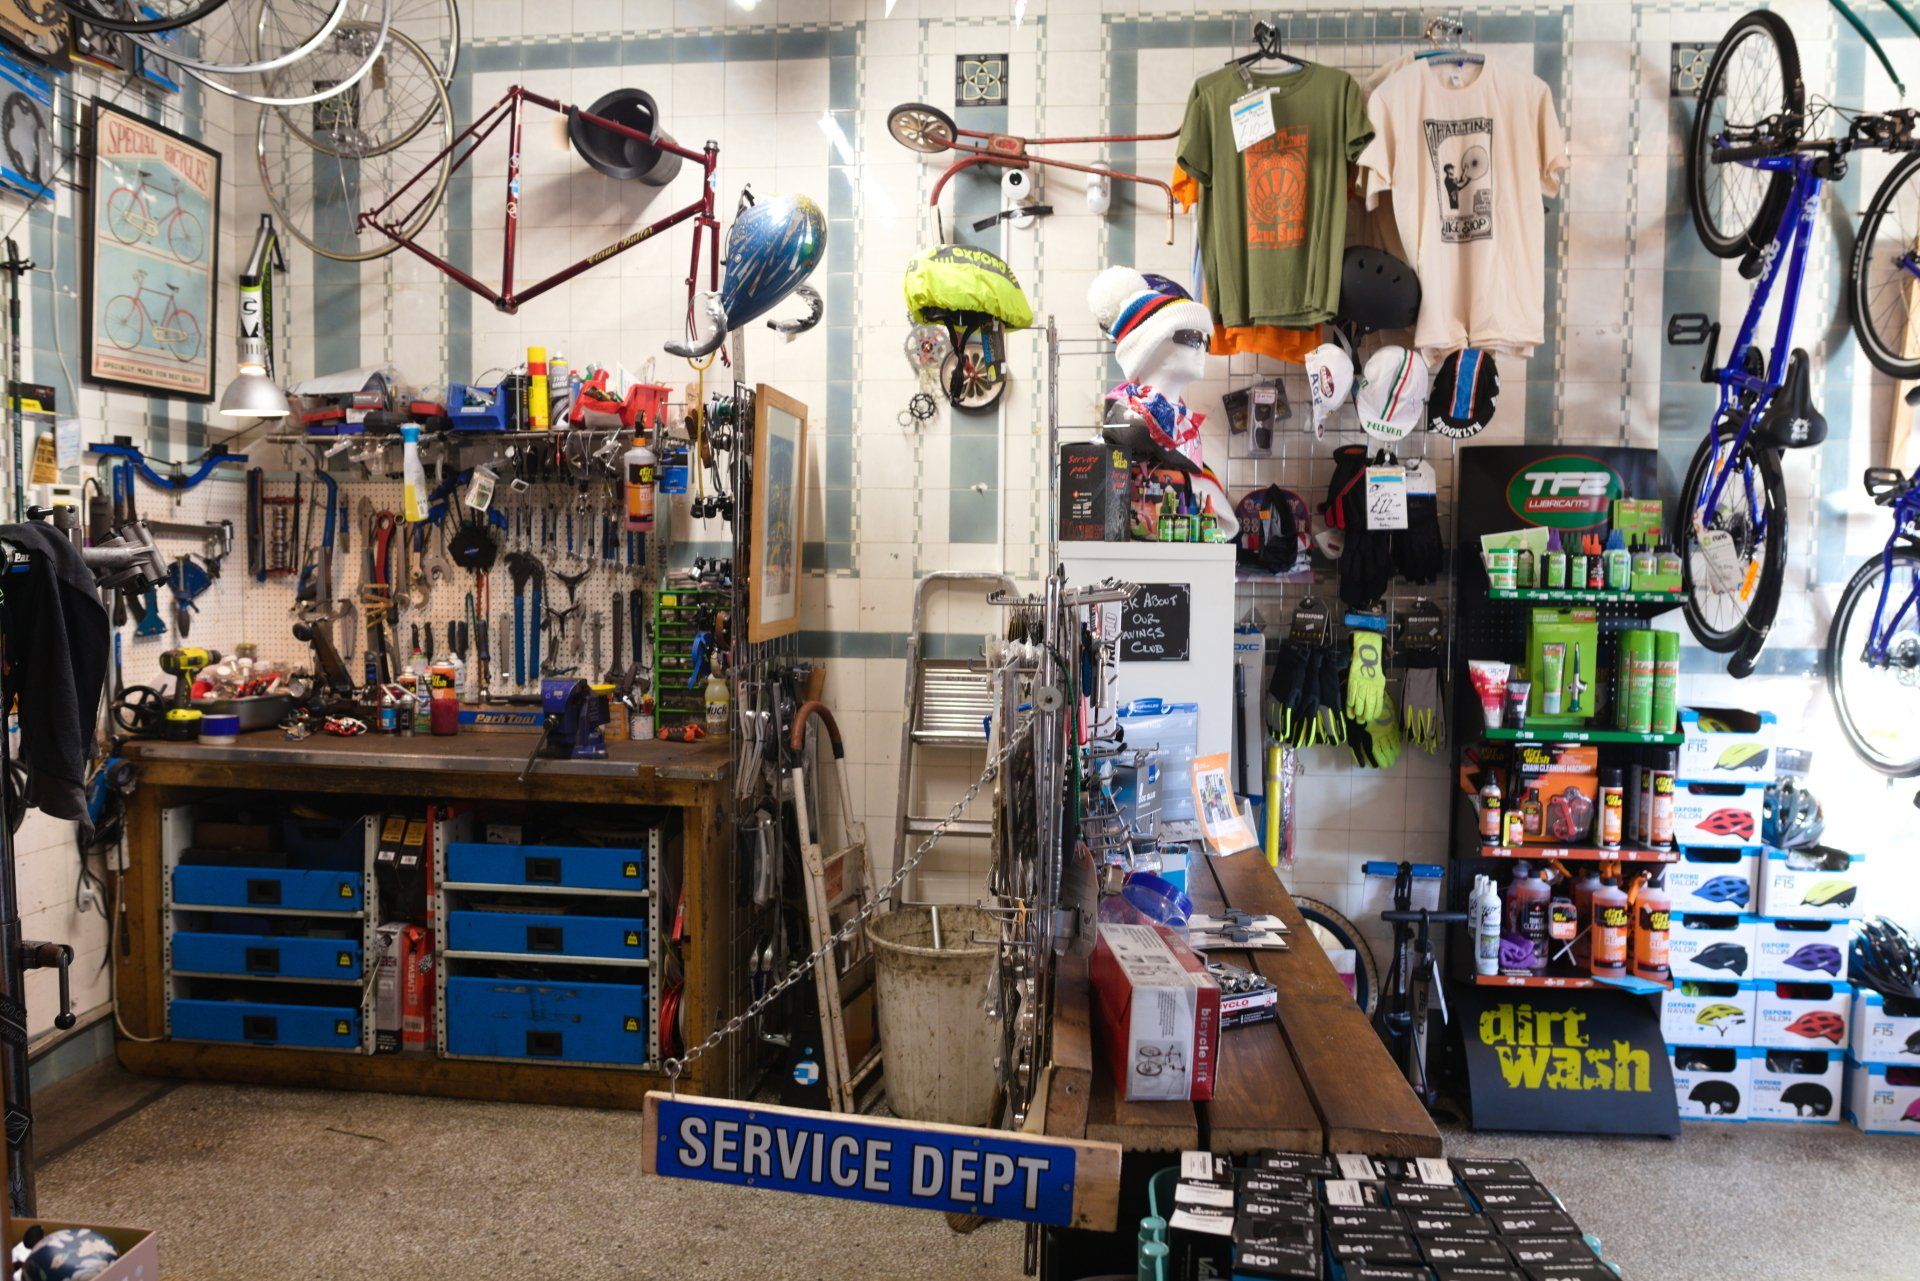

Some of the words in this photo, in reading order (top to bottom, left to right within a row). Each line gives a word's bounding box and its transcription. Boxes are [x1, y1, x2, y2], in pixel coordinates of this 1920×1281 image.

[107, 120, 157, 155] SPECIAL
[164, 143, 209, 192] BICYCLES
[952, 247, 1006, 273] OXFORD
[103, 361, 135, 375] SPECIALLY
[137, 367, 153, 378] MADE
[156, 370, 169, 380] FOR
[169, 373, 181, 381] BEST
[1367, 421, 1403, 437] 7-ELEVEN
[1432, 416, 1483, 438] BROOKLYN
[1528, 499, 1591, 509] LUBRICANTS
[14, 552, 31, 562] Par
[1121, 598, 1140, 613] SK
[1132, 613, 1160, 625] OUR
[1121, 626, 1165, 640] AVINGS
[1130, 641, 1165, 654] CLUB
[474, 712, 505, 724] Park
[507, 712, 536, 724] Tool
[1522, 763, 1539, 772] CHAIN
[1540, 764, 1566, 772] CLEANING
[1669, 879, 1699, 887] TALON
[1479, 1002, 1590, 1048] dirt
[1763, 1015, 1792, 1023] TALON
[1197, 1008, 1212, 1058] bicycle
[1873, 1027, 1894, 1036] F15
[1197, 1061, 1208, 1083] lift
[1494, 1040, 1652, 1092] wash
[1873, 1095, 1895, 1104] F15
[679, 1116, 893, 1192] SERVICE
[911, 1144, 1050, 1211] DEPT
